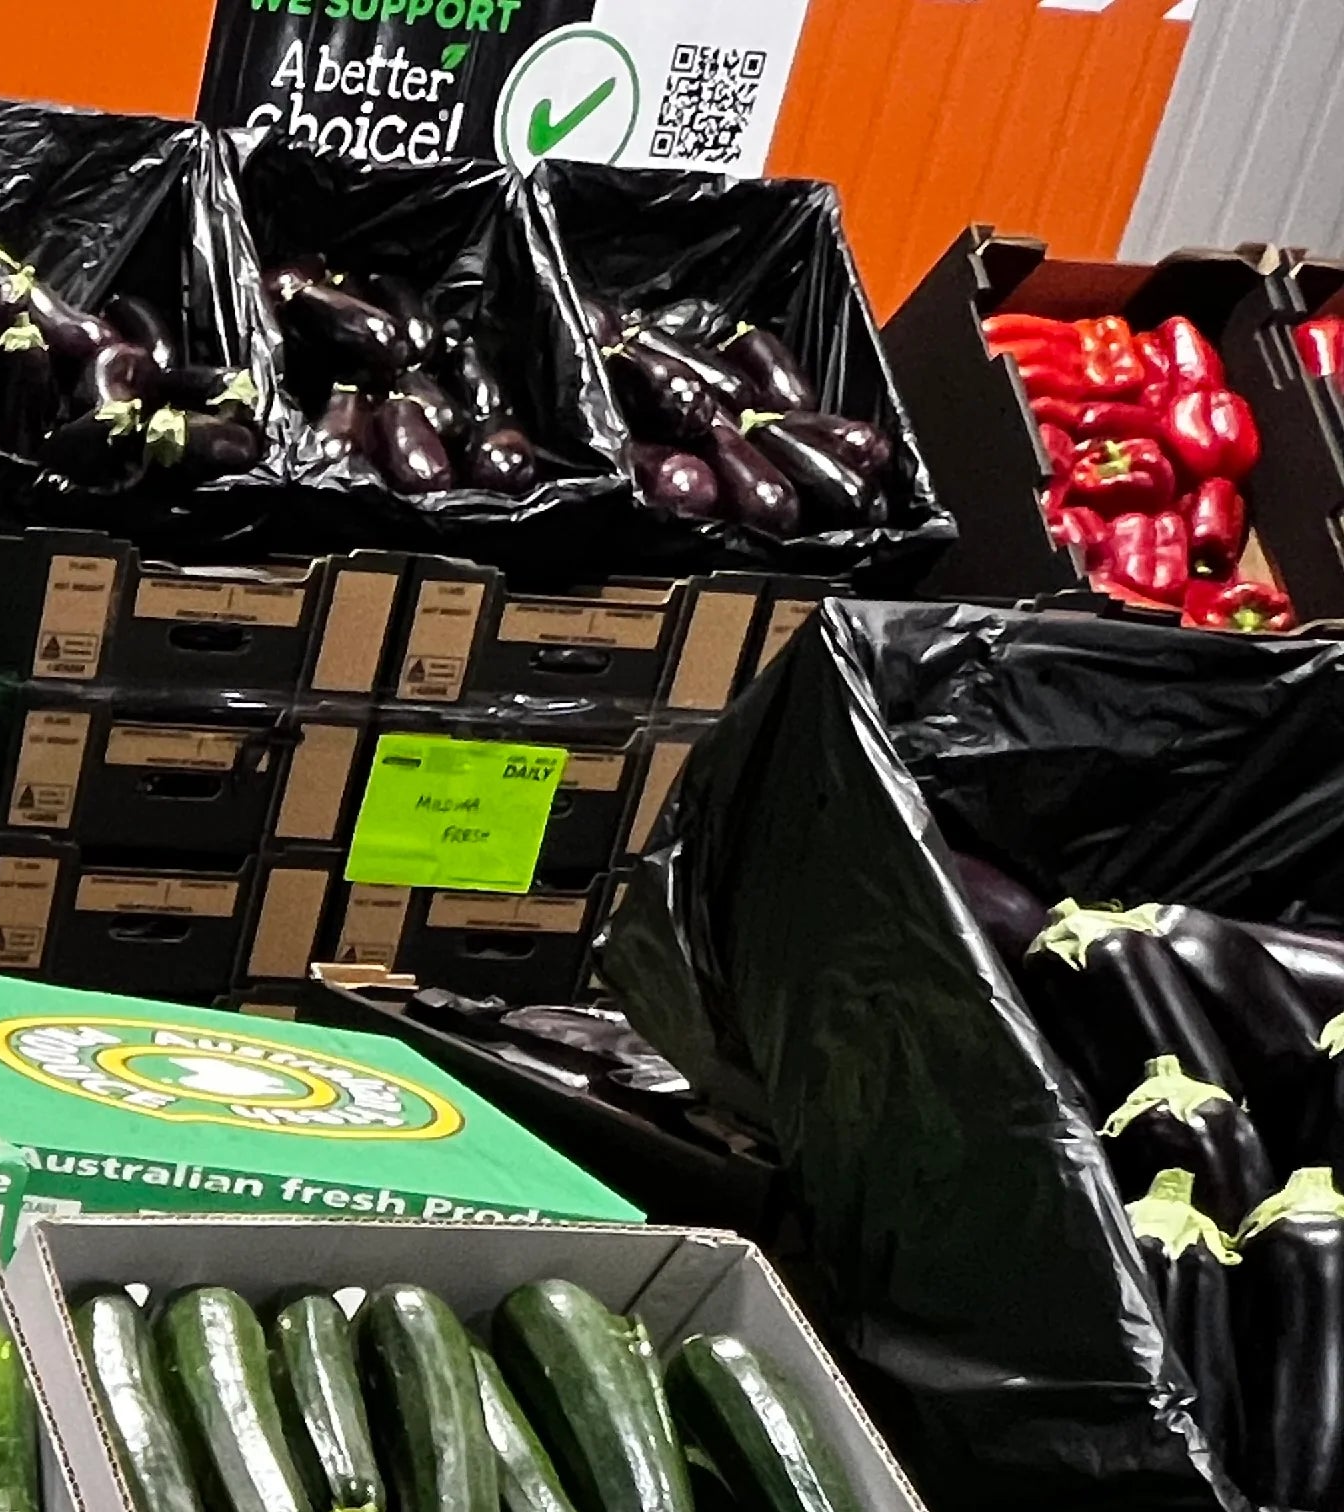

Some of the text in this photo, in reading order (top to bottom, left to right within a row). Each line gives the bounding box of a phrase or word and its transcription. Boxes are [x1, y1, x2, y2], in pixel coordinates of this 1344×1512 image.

[325, 0, 521, 33] SUPPORT
[271, 39, 454, 102] A better
[17, 1146, 264, 1198] Australian
[280, 1178, 407, 1216] fresh
